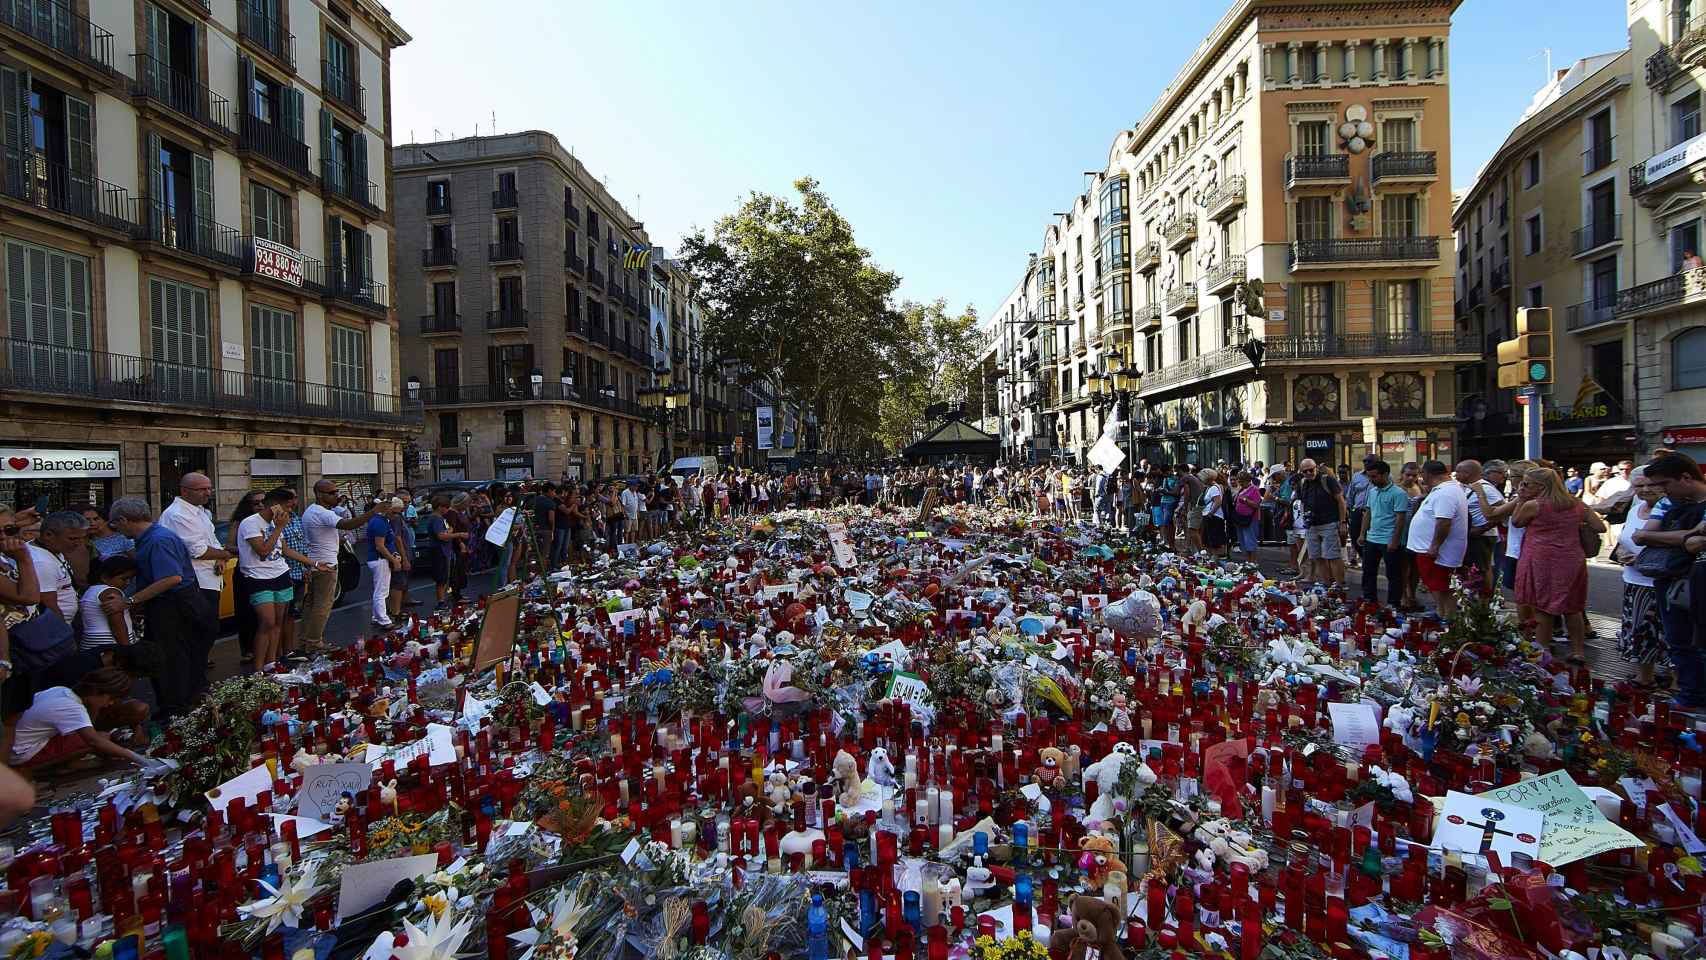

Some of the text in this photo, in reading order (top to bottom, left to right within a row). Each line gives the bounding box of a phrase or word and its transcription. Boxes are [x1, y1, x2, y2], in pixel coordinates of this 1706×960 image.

[256, 248, 273, 266] 934
[275, 254, 290, 271] 880
[259, 264, 301, 285] FOR SALE
[1306, 440, 1328, 448] BBVA
[32, 457, 115, 471] Barcelona
[892, 681, 914, 701] ISLAM
